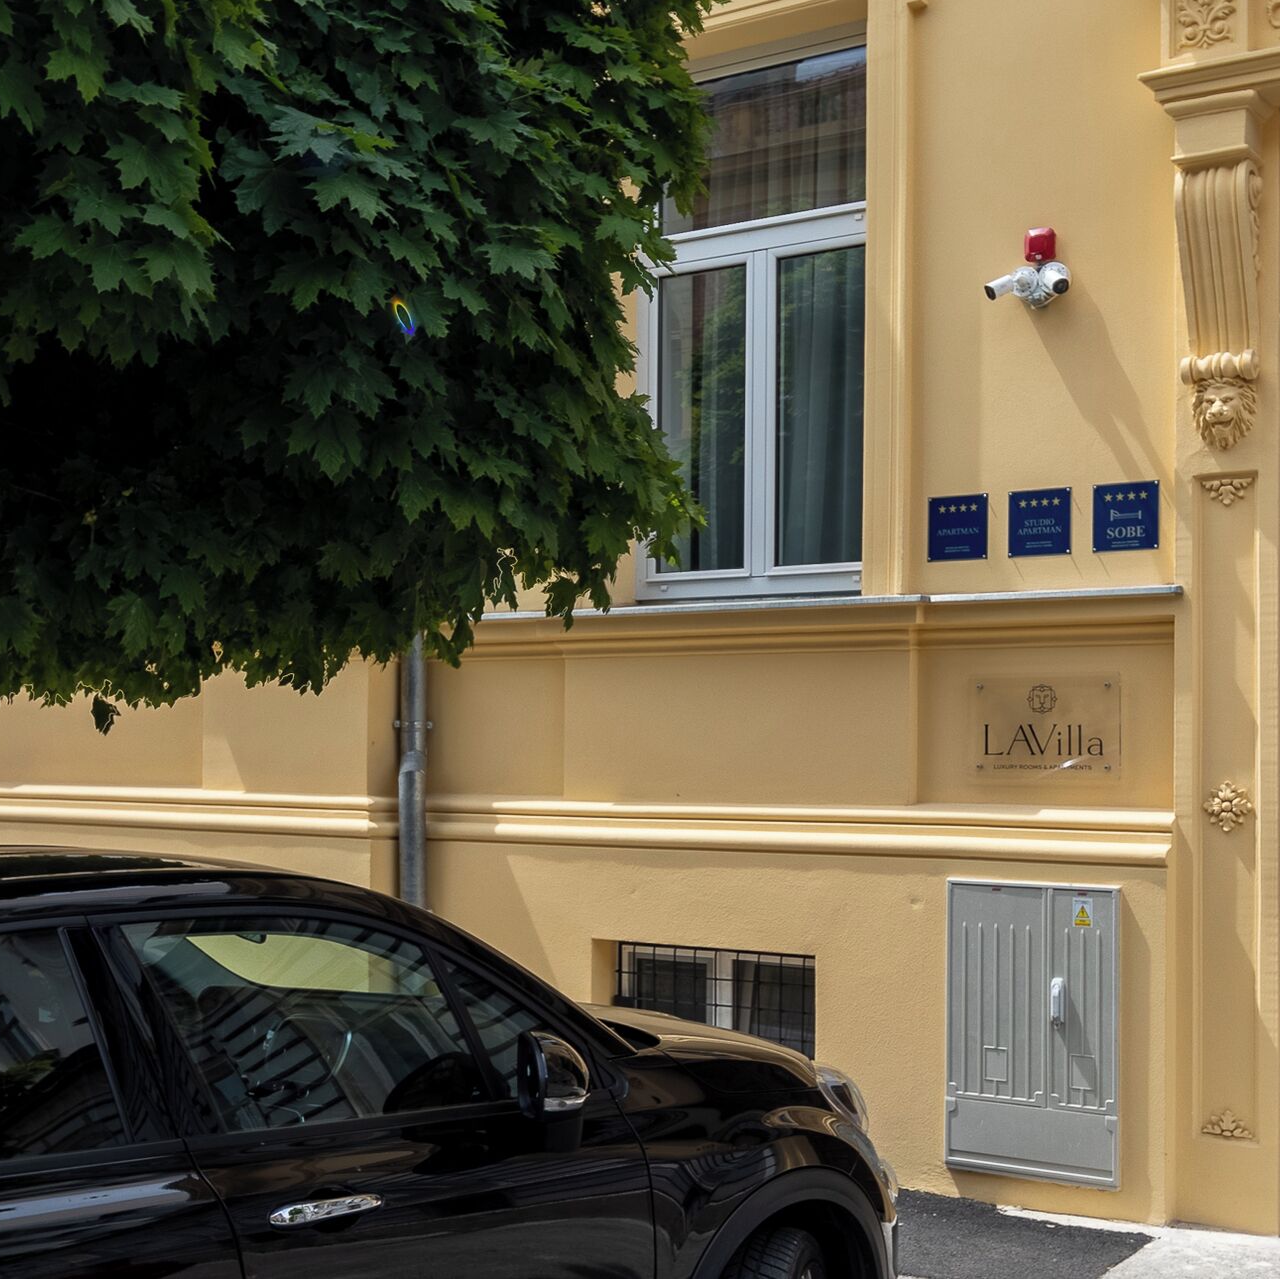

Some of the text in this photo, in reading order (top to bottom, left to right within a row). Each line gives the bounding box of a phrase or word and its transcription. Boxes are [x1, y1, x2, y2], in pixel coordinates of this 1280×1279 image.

[1024, 519, 1055, 527] STUDIO
[937, 527, 980, 536] APARTMAN
[1017, 526, 1062, 536] APARTMAN
[1106, 525, 1146, 539] SOBE
